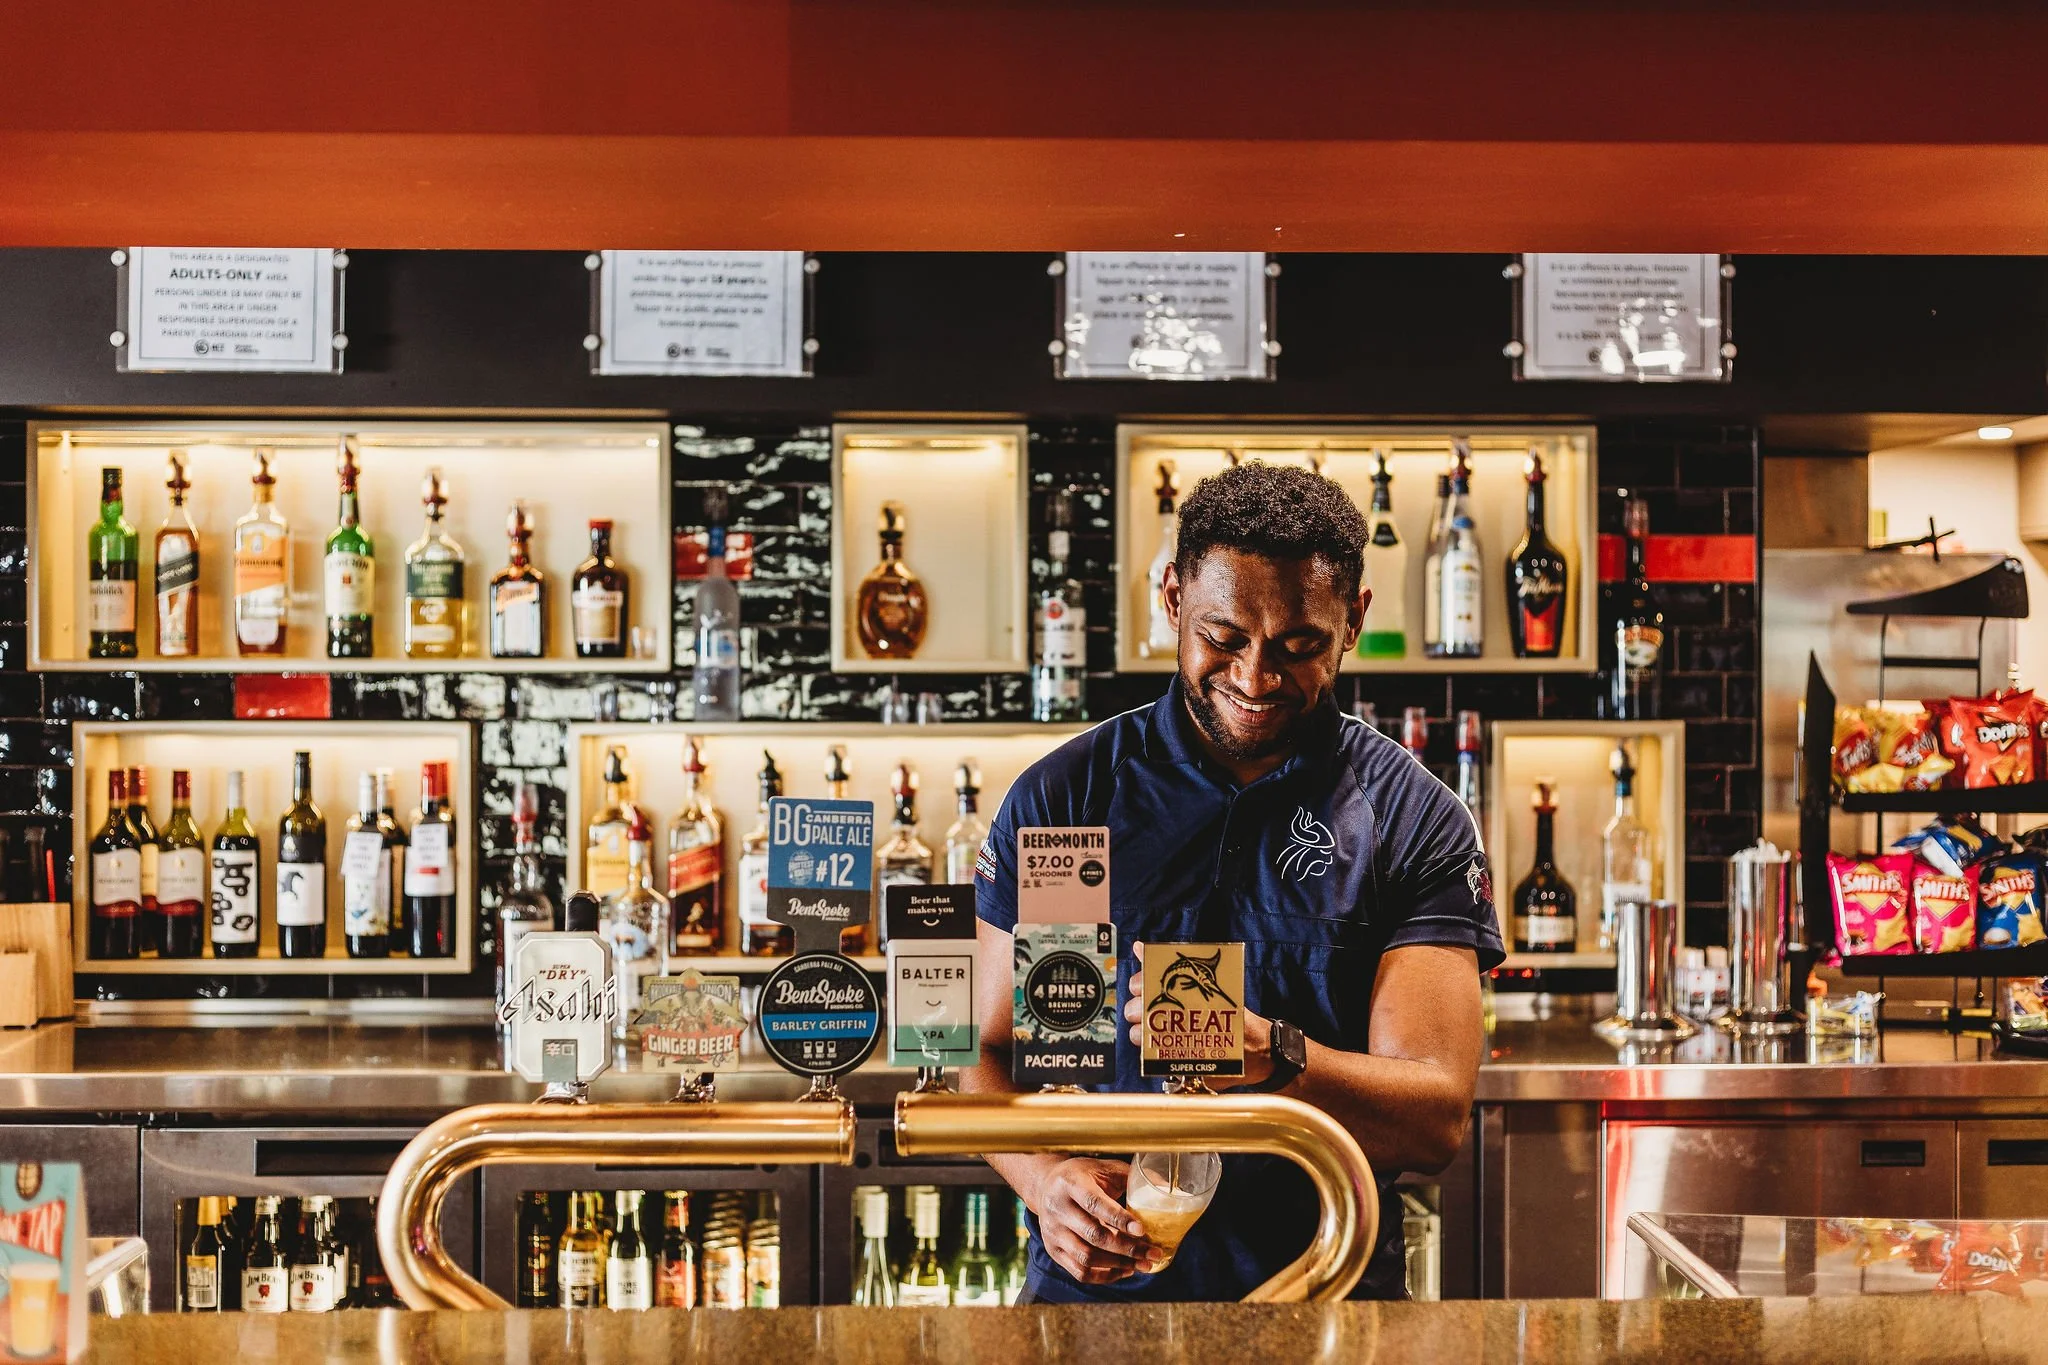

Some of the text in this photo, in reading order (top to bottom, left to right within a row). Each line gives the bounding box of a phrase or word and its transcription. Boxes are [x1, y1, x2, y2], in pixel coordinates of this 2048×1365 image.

[169, 268, 262, 280] ADULTS-ONLY
[774, 803, 871, 846] BG CANBERRA
[812, 825, 871, 846] PALE ALE
[1023, 833, 1105, 848] BEER MONTH
[1027, 855, 1074, 869] $7.00
[816, 853, 855, 887] #12
[911, 896, 931, 904] Beer
[787, 897, 851, 920] BentSpoke
[907, 906, 954, 915] makes you
[793, 961, 820, 973] CANBERRA
[821, 960, 833, 969] PALE
[902, 969, 965, 979] BALTER
[700, 983, 734, 1006] UNION
[775, 979, 865, 1010] BentSpoke
[1034, 984, 1096, 998] 4 PINES
[498, 975, 618, 1024] Asahi
[772, 1020, 867, 1031] BARLEY GRIFFIN
[1148, 1010, 1237, 1033] GREAT
[648, 1034, 734, 1055] GINGER BEER
[1150, 1034, 1234, 1048] NORTHERN
[546, 1042, 575, 1056] 辛口
[1158, 1049, 1206, 1058] BREWING
[1024, 1054, 1104, 1068] PACIFIC ALE
[1170, 1063, 1217, 1072] SUPER CRISP
[28, 1202, 62, 1254] TAP
